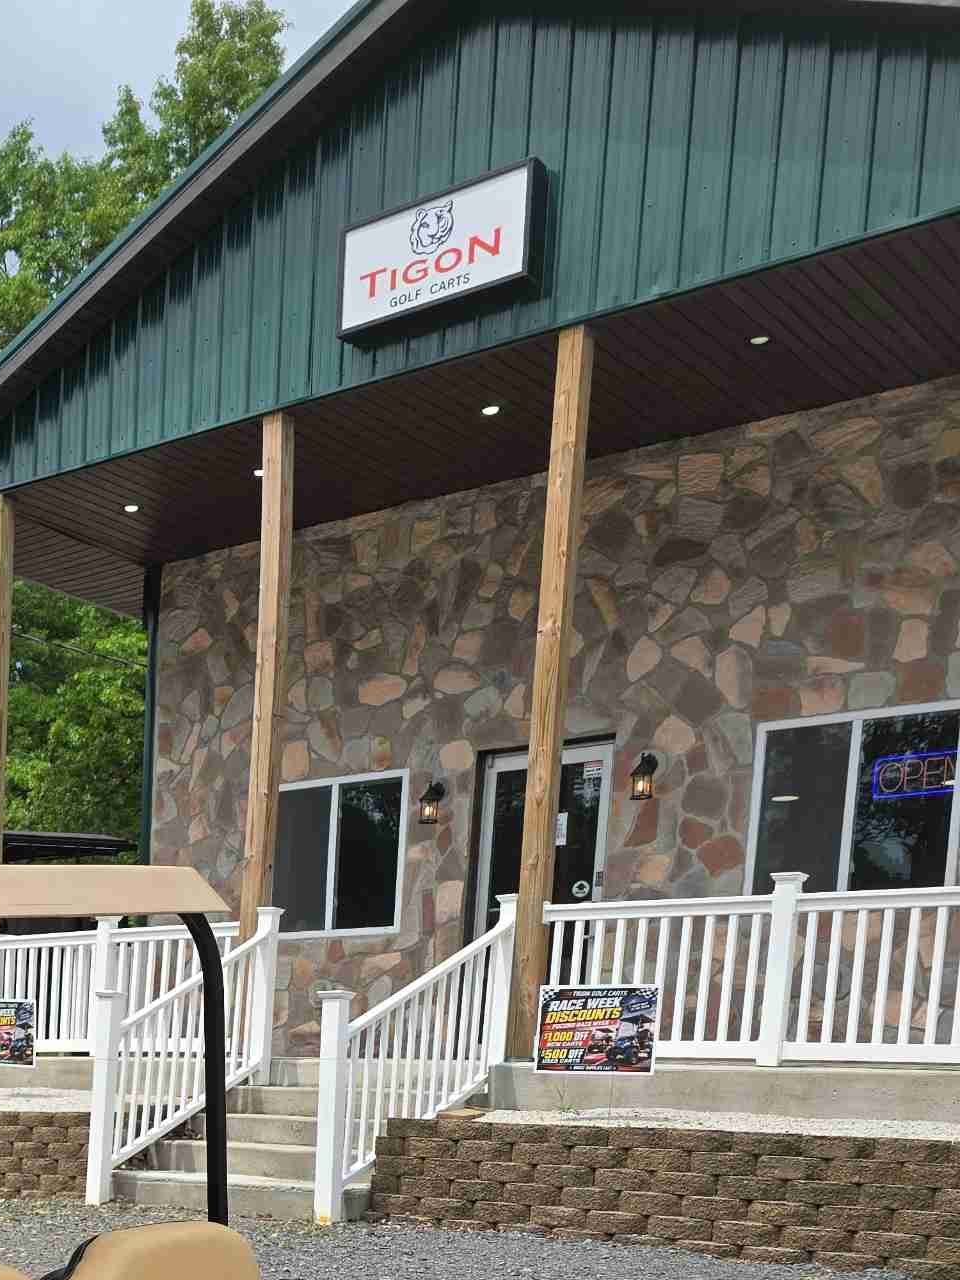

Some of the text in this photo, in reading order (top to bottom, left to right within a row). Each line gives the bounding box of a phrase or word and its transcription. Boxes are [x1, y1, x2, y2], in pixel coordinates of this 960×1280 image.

[359, 227, 502, 298] TIGON
[389, 273, 471, 308] GOLF CARTS
[544, 1008, 623, 1024] DISCOUNTS
[548, 999, 586, 1012] RACE
[586, 997, 624, 1009] WEEK
